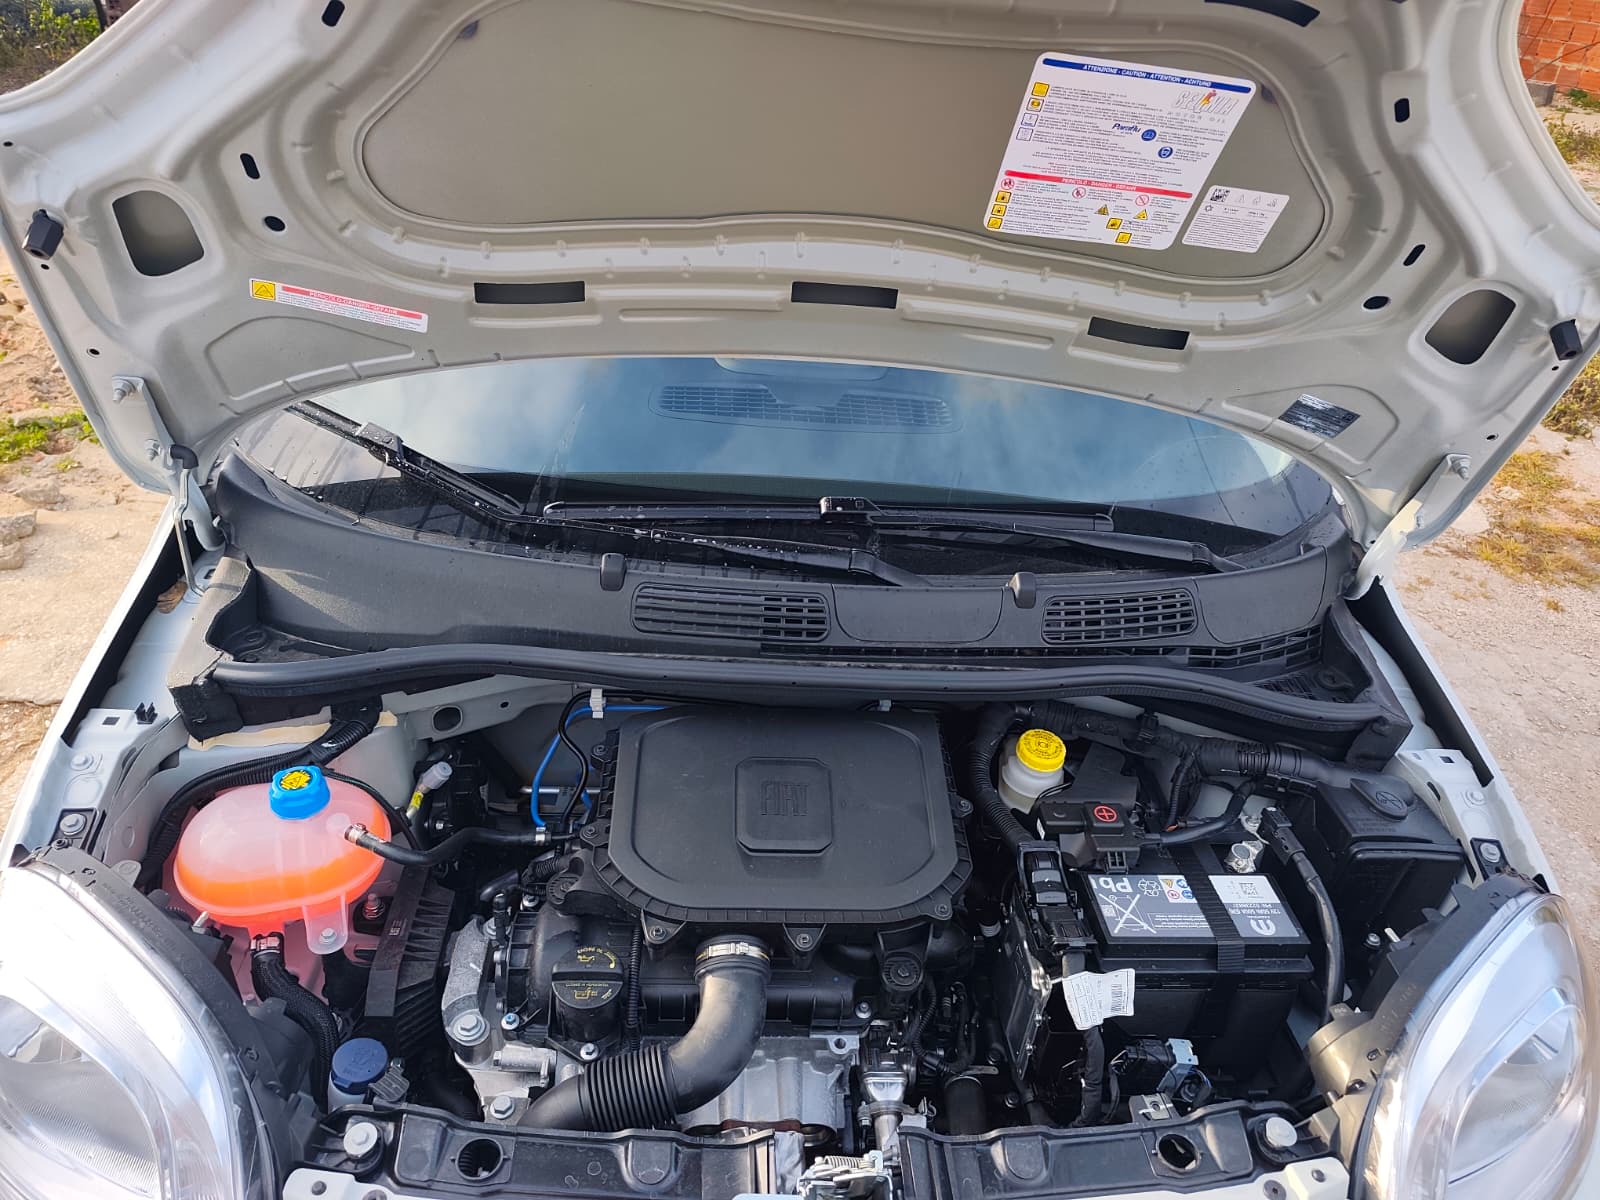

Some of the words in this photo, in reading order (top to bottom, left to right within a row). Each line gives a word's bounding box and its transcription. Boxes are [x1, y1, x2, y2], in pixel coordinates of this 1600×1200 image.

[1082, 64, 1117, 74] ATTENZIONE
[1121, 69, 1146, 78] CAUTION
[1149, 72, 1180, 83] ATTENTION
[1184, 77, 1212, 87] ACHTUNG
[1099, 877, 1133, 893] Pb
